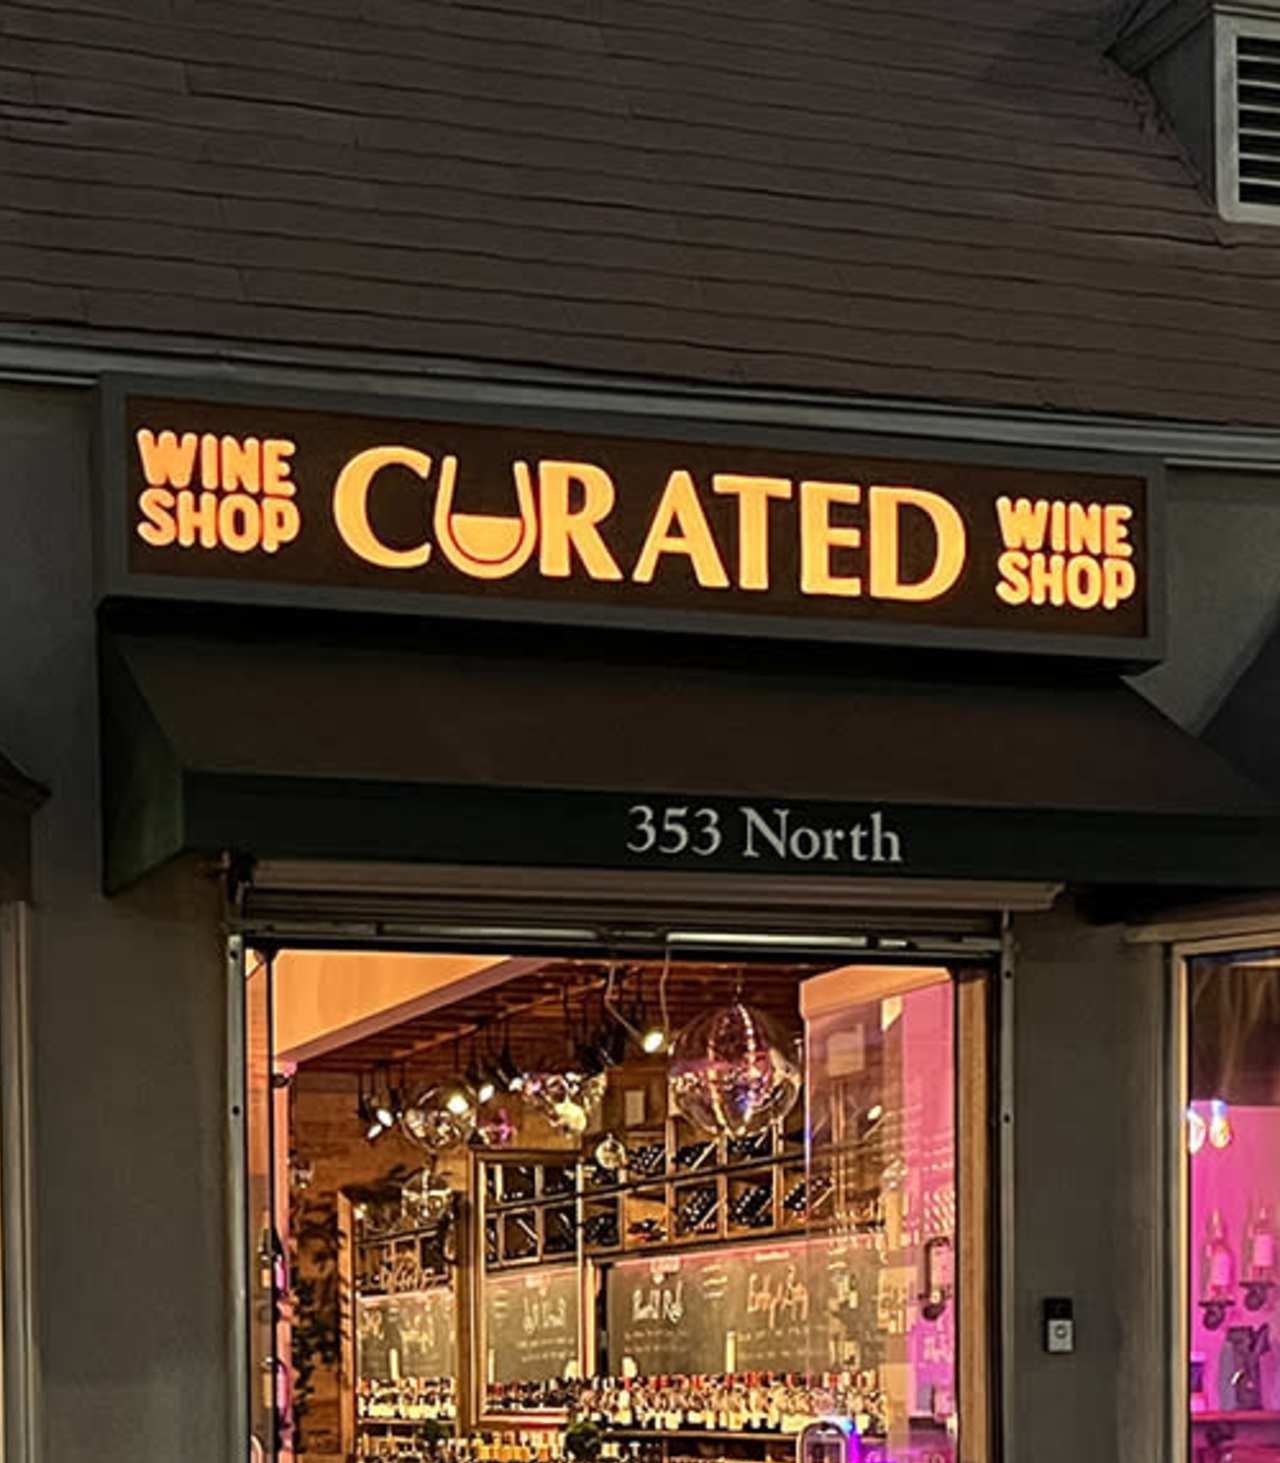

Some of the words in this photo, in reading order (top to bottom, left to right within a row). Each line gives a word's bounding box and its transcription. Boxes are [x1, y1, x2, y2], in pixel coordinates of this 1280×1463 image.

[136, 428, 297, 497] WINE
[136, 486, 301, 554] SHOP
[333, 444, 967, 602] CURATED
[995, 496, 1134, 558] WINE
[995, 551, 1137, 611] SHOP
[626, 805, 722, 857] 353
[738, 806, 903, 862] North
